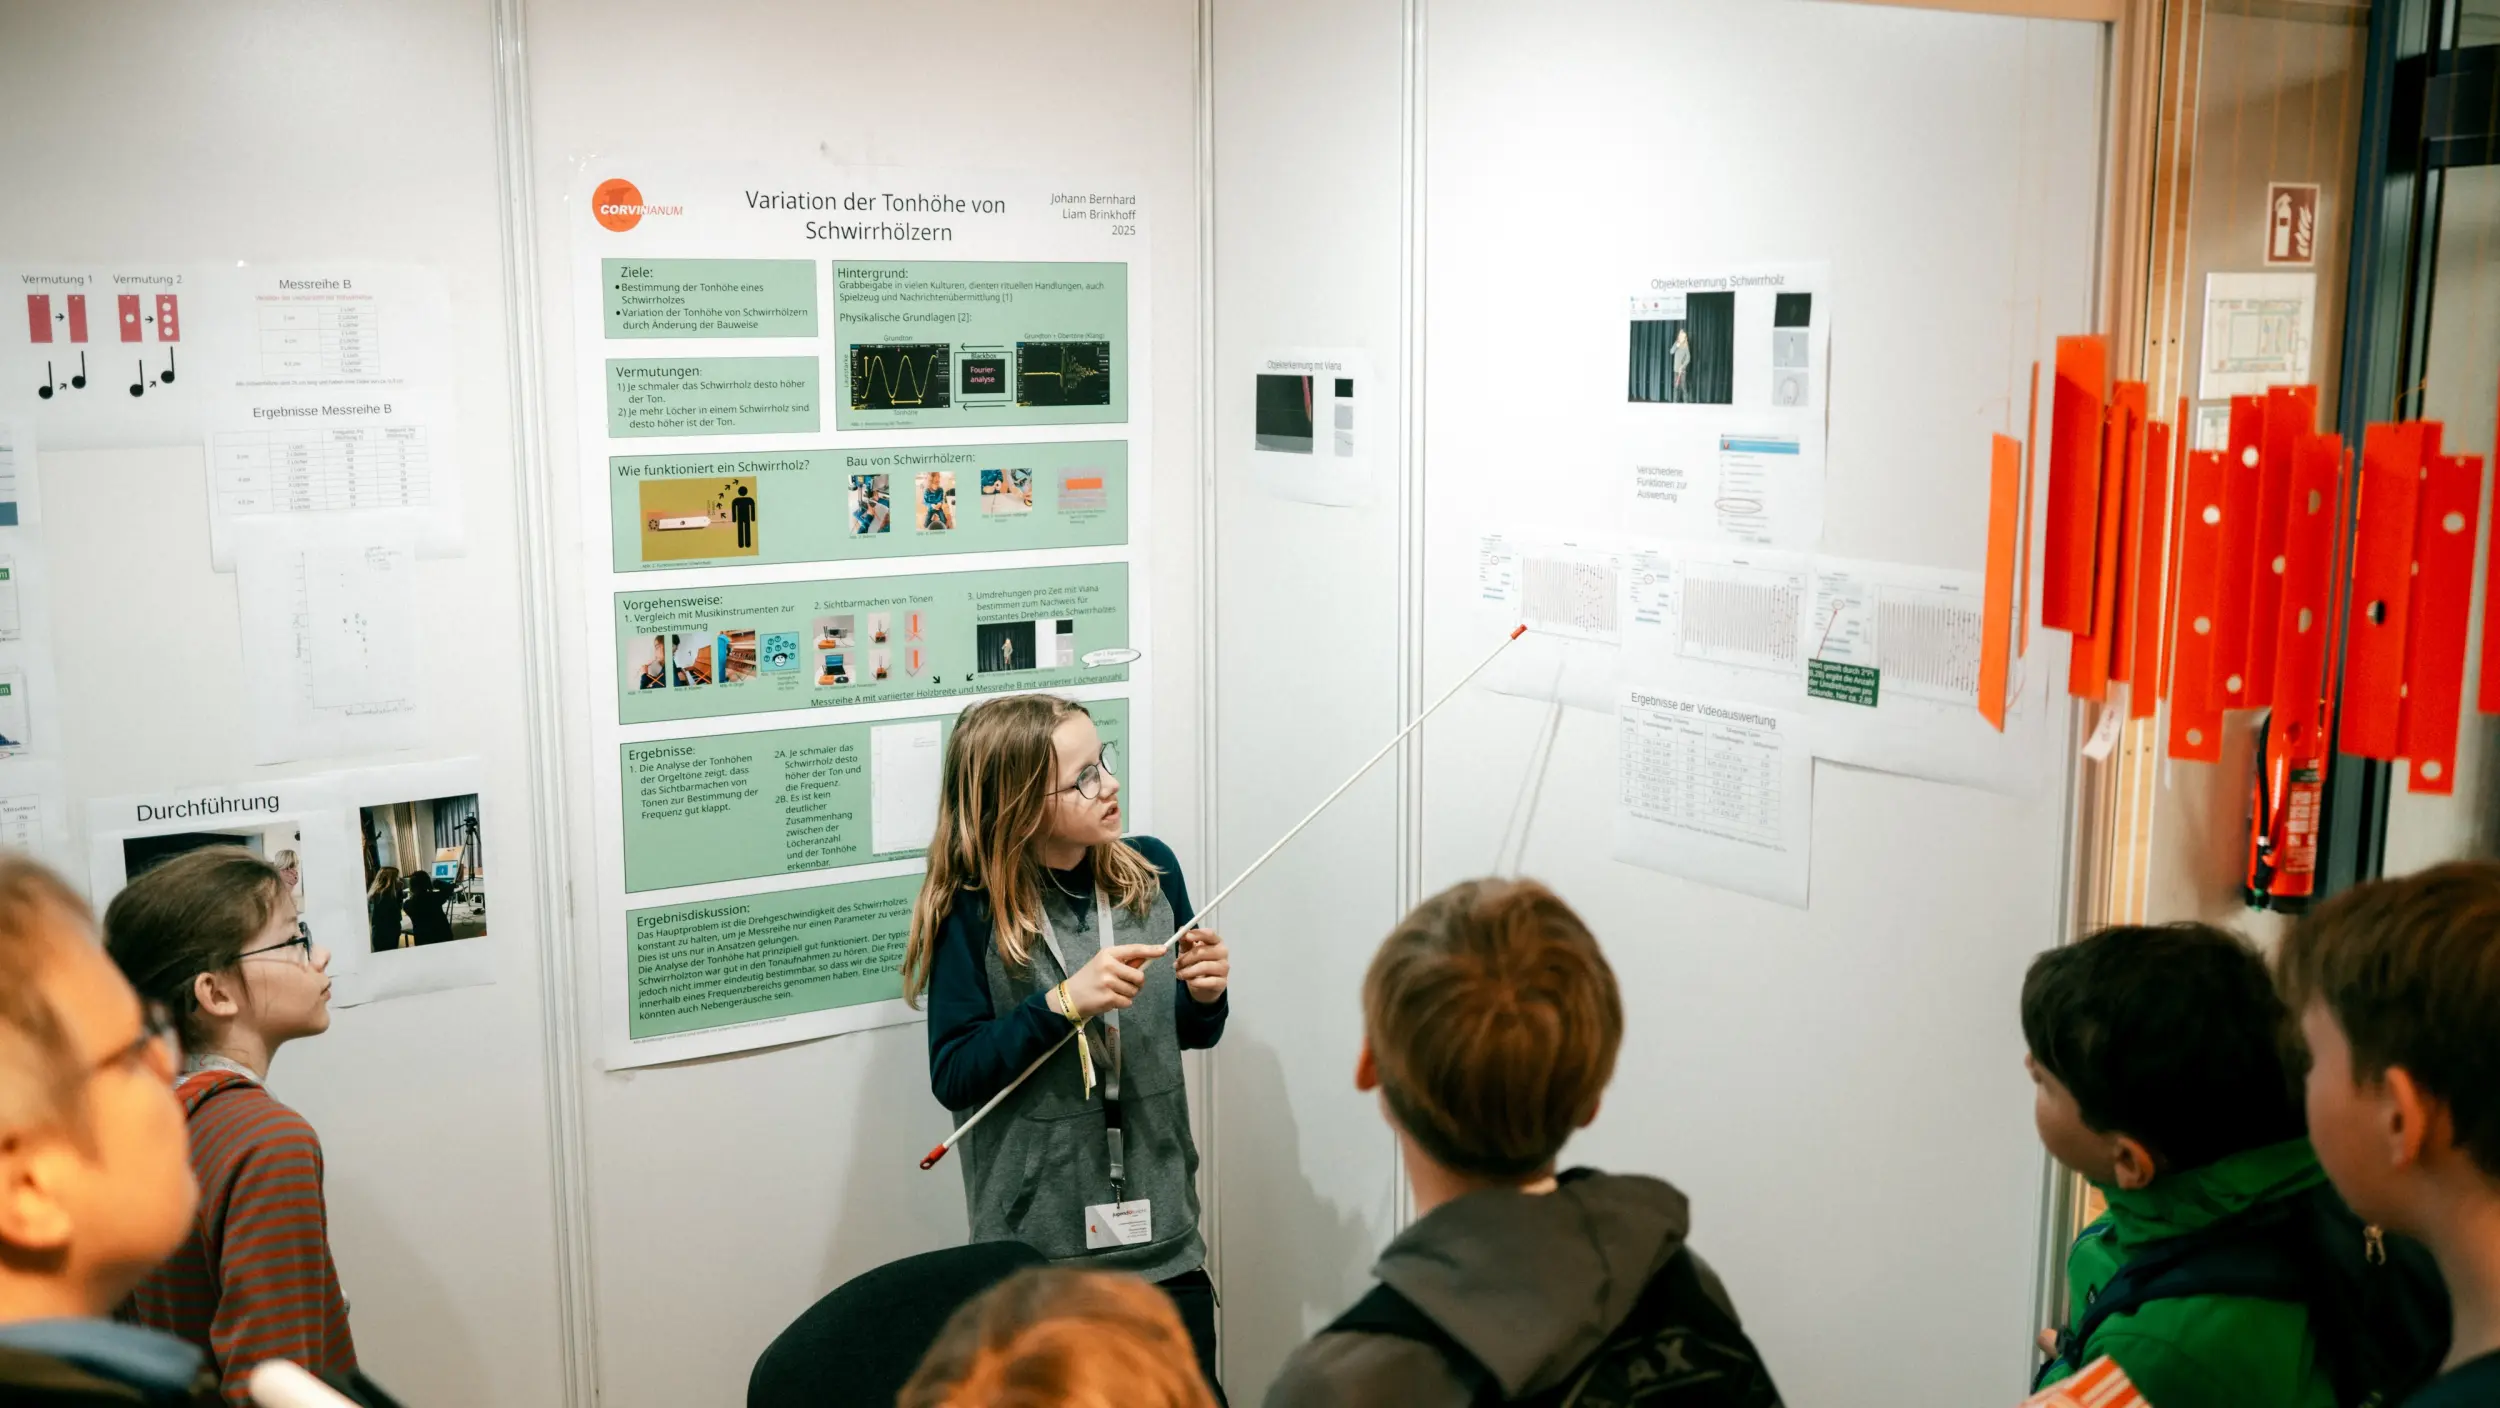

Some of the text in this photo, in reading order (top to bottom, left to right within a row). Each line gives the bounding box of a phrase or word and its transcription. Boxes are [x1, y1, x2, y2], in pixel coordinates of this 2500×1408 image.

[746, 191, 1004, 213] Variation der Tonhöhe von
[1050, 193, 1135, 205] Johann Bernhard
[1062, 208, 1136, 220] Liam Brinkhoff
[806, 221, 951, 240] Schwirrhölzern
[1111, 225, 1135, 235] 2025
[620, 266, 652, 278] Ziele:
[837, 268, 908, 279] Hintergrund:
[21, 274, 92, 286] Vermutung 1
[112, 274, 182, 286] Vermutung 2
[279, 279, 351, 289] Messreihe B
[838, 279, 892, 291] Grabbeigabe
[894, 281, 902, 289] in
[930, 281, 966, 290] Kulturen,
[968, 282, 998, 290] dienten
[1000, 282, 1034, 291] rituellen
[1034, 282, 1083, 291] Handlungen,
[1650, 274, 1784, 289] Objekterkennung Schwirrholz
[621, 283, 680, 293] Bestimmung
[682, 283, 697, 291] der
[701, 283, 738, 291] Tonhöhe
[621, 295, 685, 304] Schwirrholzes
[839, 293, 879, 303] Spielzeug
[881, 293, 897, 301] und
[899, 293, 1000, 302] Nachrichtenübermittlung
[621, 308, 663, 316] Variation
[665, 308, 680, 317] der
[683, 308, 722, 316] Tonhöhe
[742, 308, 807, 316] Schwirrhölzern
[839, 312, 971, 323] Physikalische Grundlagen [2]:
[622, 320, 758, 331] durch Änderung der Bauweise
[616, 367, 701, 379] Vermutungen:
[618, 380, 805, 392] 1) Je schmaler das Schwirrholz desto höher
[628, 394, 665, 403] der Ton.
[253, 403, 391, 419] Ergebnisse Messreihe B
[617, 407, 626, 417] 2)
[628, 408, 636, 418] Je
[639, 407, 663, 415] mehr
[666, 406, 696, 415] Löcher
[709, 406, 736, 414] einem
[739, 404, 789, 413] Schwirrholz
[791, 404, 809, 412] sind
[629, 417, 735, 428] desto höher ist der Ton.
[846, 453, 975, 466] Bau von Schwirrhölzern:
[617, 460, 809, 476] Wie funktioniert ein Schwirrholz?
[1636, 477, 1687, 489] Funktionen zur
[1636, 490, 1677, 502] Auswertung
[623, 596, 722, 612] Vorgehensweise:
[814, 601, 821, 610] 2.
[823, 598, 889, 609] Sichtbarmachen
[909, 595, 933, 603] Tönen
[625, 614, 632, 622] 1.
[634, 612, 675, 623] Vergleich
[694, 606, 778, 617] Musikinstrumenten
[636, 623, 707, 635] Tonbestimmung
[1631, 692, 1776, 729] Ergebnisse der Videoauswertung
[628, 747, 695, 760] Ergebnisse:
[629, 755, 752, 773] 1. Die Analyse der Tonhöhen
[640, 767, 749, 784] der Orgeltöne zeigt, dass
[640, 788, 656, 796] das
[658, 781, 729, 794] Sichtbarmachen
[641, 799, 668, 807] Tönen
[687, 791, 741, 802] Bestimmung
[137, 796, 279, 821] Durchführung
[641, 804, 730, 819] Frequenz gut klappt.
[637, 905, 749, 927] Ergebnisdiskussion:
[639, 991, 792, 1019] könnten auch Nebengeräusche sein.
